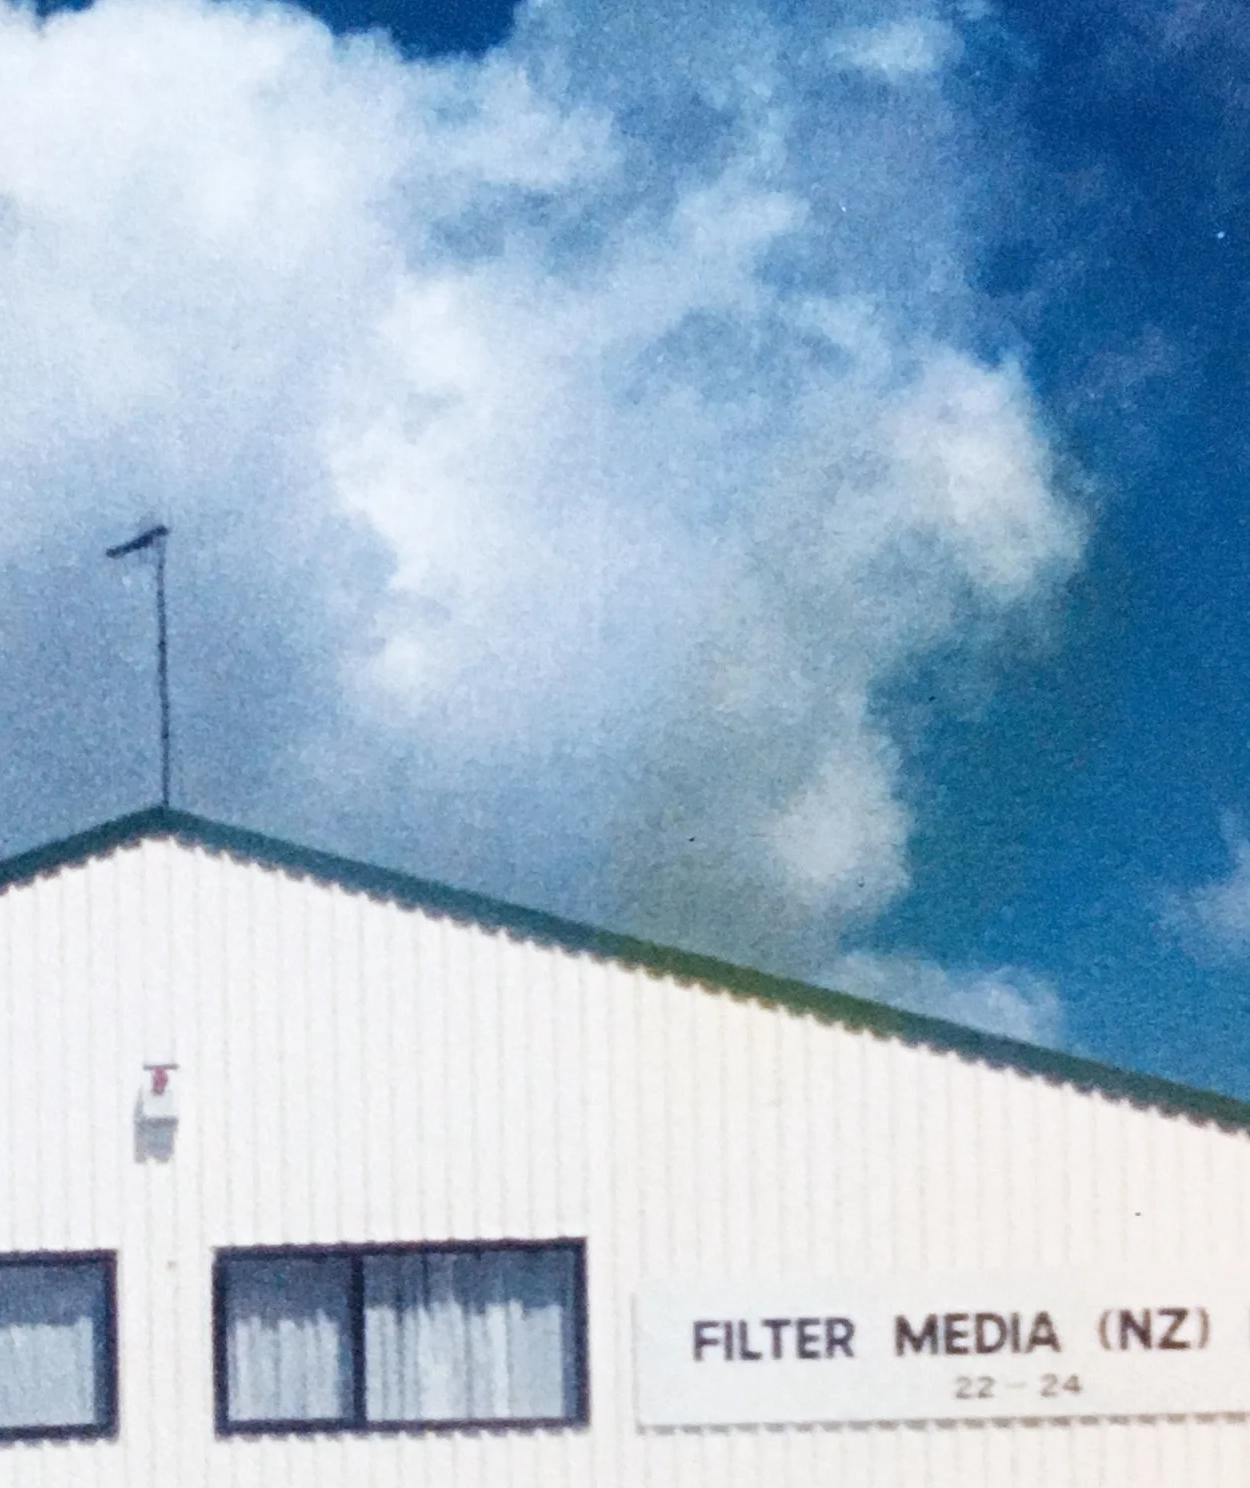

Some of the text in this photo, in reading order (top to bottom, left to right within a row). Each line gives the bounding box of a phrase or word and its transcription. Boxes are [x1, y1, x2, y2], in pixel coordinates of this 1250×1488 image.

[692, 1317, 855, 1361] FILTER
[894, 1310, 1062, 1356] MEDIA
[1097, 1306, 1211, 1351] (NZ)
